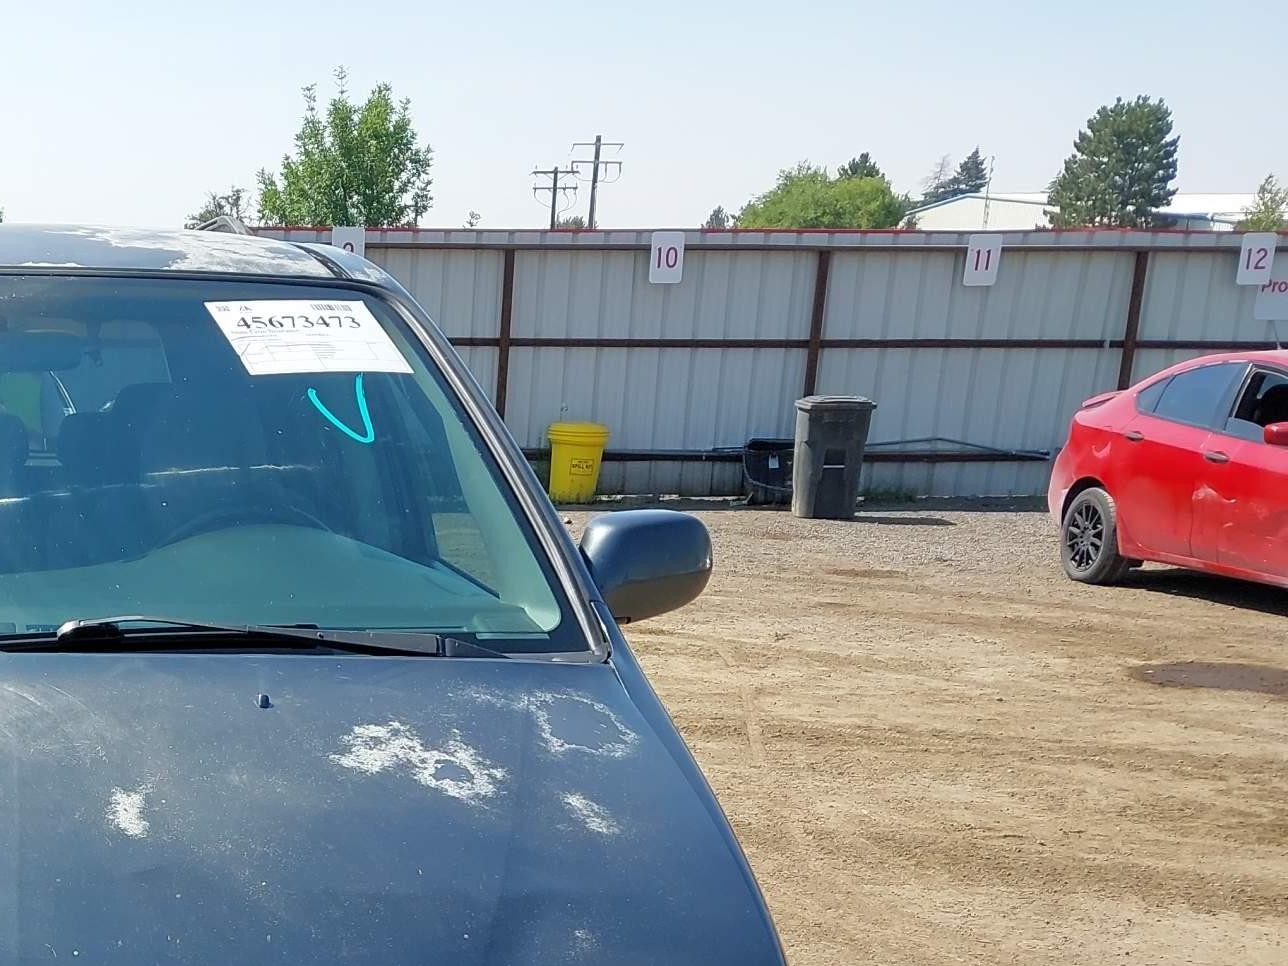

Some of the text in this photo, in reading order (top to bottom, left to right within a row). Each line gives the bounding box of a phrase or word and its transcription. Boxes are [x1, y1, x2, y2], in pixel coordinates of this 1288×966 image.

[656, 246, 678, 269] 10
[974, 248, 992, 271] 11
[1245, 247, 1268, 270] 12
[236, 315, 361, 329] 45673473
